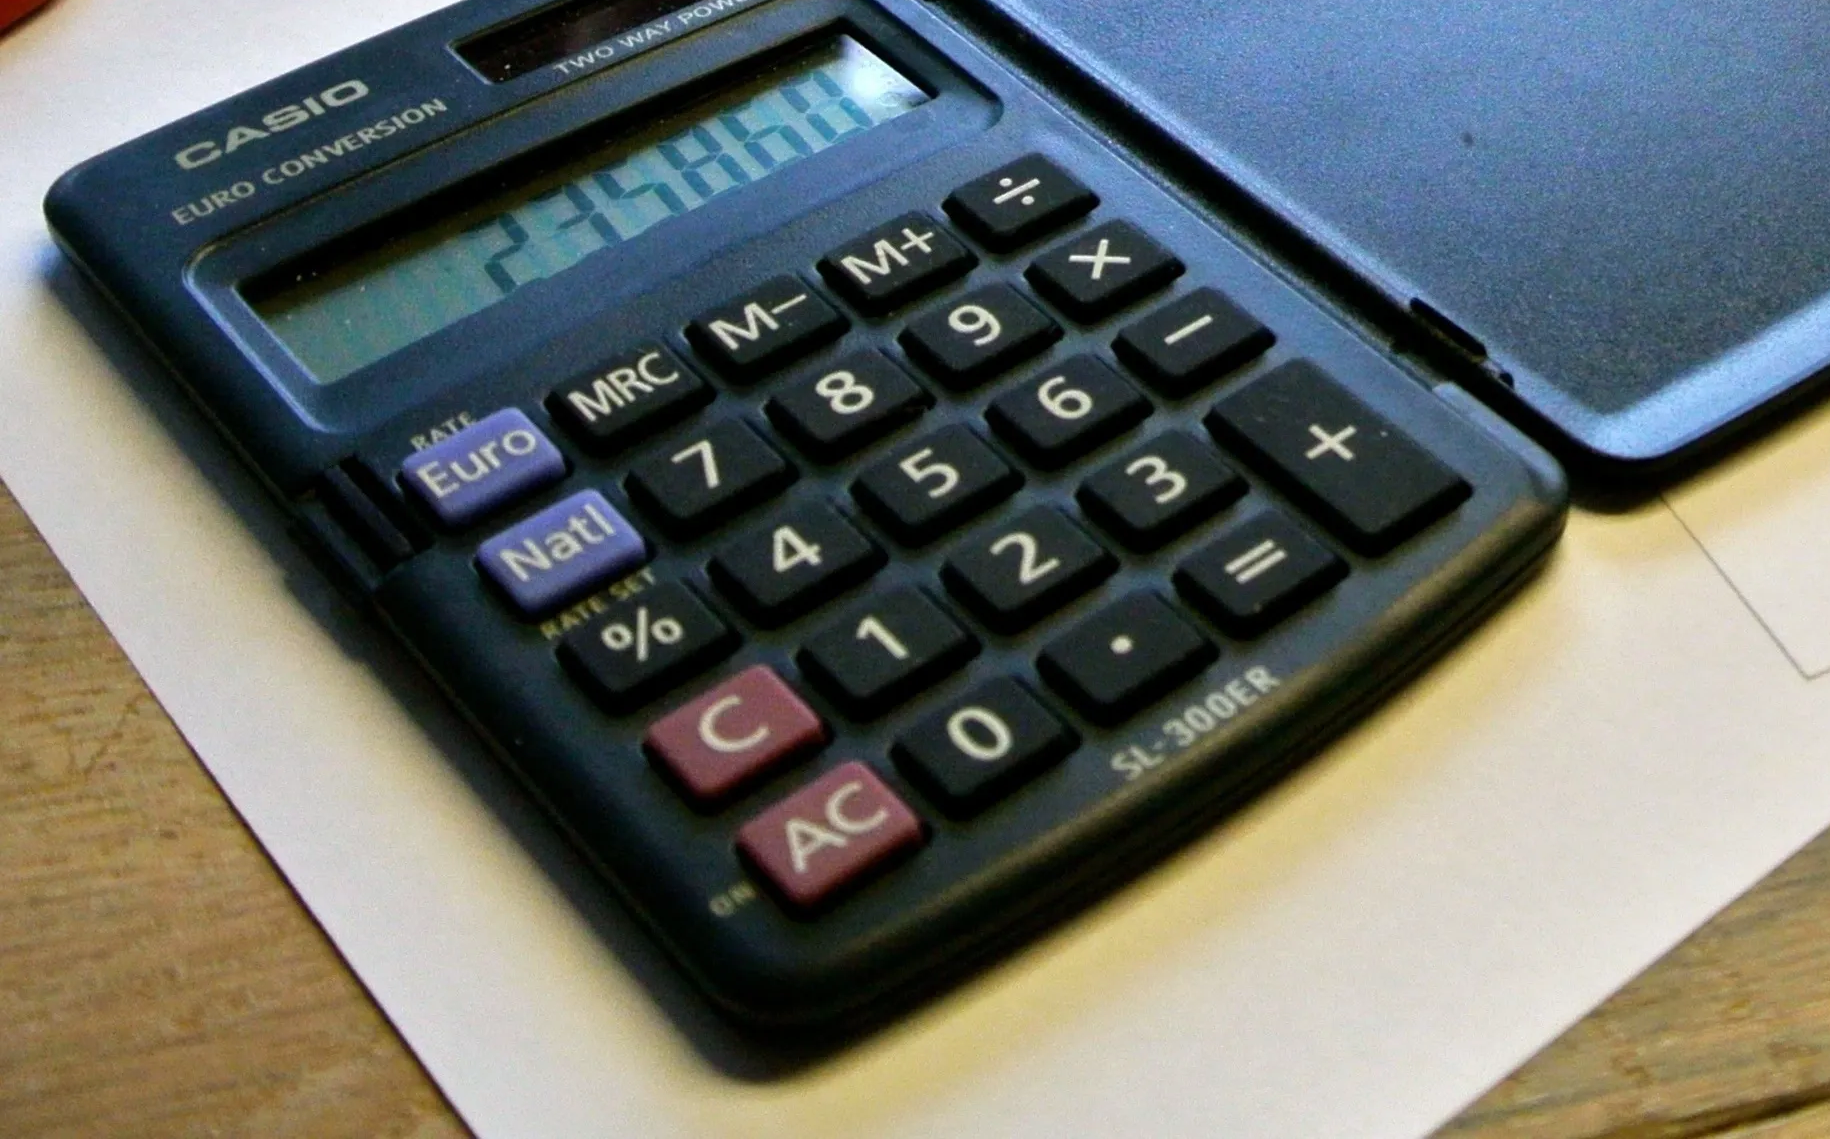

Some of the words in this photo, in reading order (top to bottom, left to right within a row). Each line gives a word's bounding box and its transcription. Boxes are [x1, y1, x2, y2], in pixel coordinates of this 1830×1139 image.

[551, 45, 615, 75] TWO
[619, 20, 675, 49] WAY
[174, 79, 370, 170] CASIO
[171, 180, 256, 226] EURO
[262, 98, 448, 185] CONVERSION
[840, 227, 935, 285] M+
[947, 304, 1002, 347] 9
[567, 351, 679, 422] MRC
[815, 370, 875, 415] 8
[1037, 375, 1093, 420] 6
[416, 429, 536, 500] Euro
[671, 439, 721, 489] 7
[899, 448, 960, 498] 5
[1125, 454, 1188, 504] 3
[500, 503, 616, 583] Natl
[772, 525, 823, 572] 4
[989, 531, 1061, 585] 2
[601, 606, 683, 662] %
[856, 616, 909, 660] 1
[699, 695, 771, 752] C
[946, 706, 1013, 761] 0
[1110, 665, 1281, 782] SL-300ER
[785, 780, 888, 874] AC
[709, 880, 756, 917] ON
